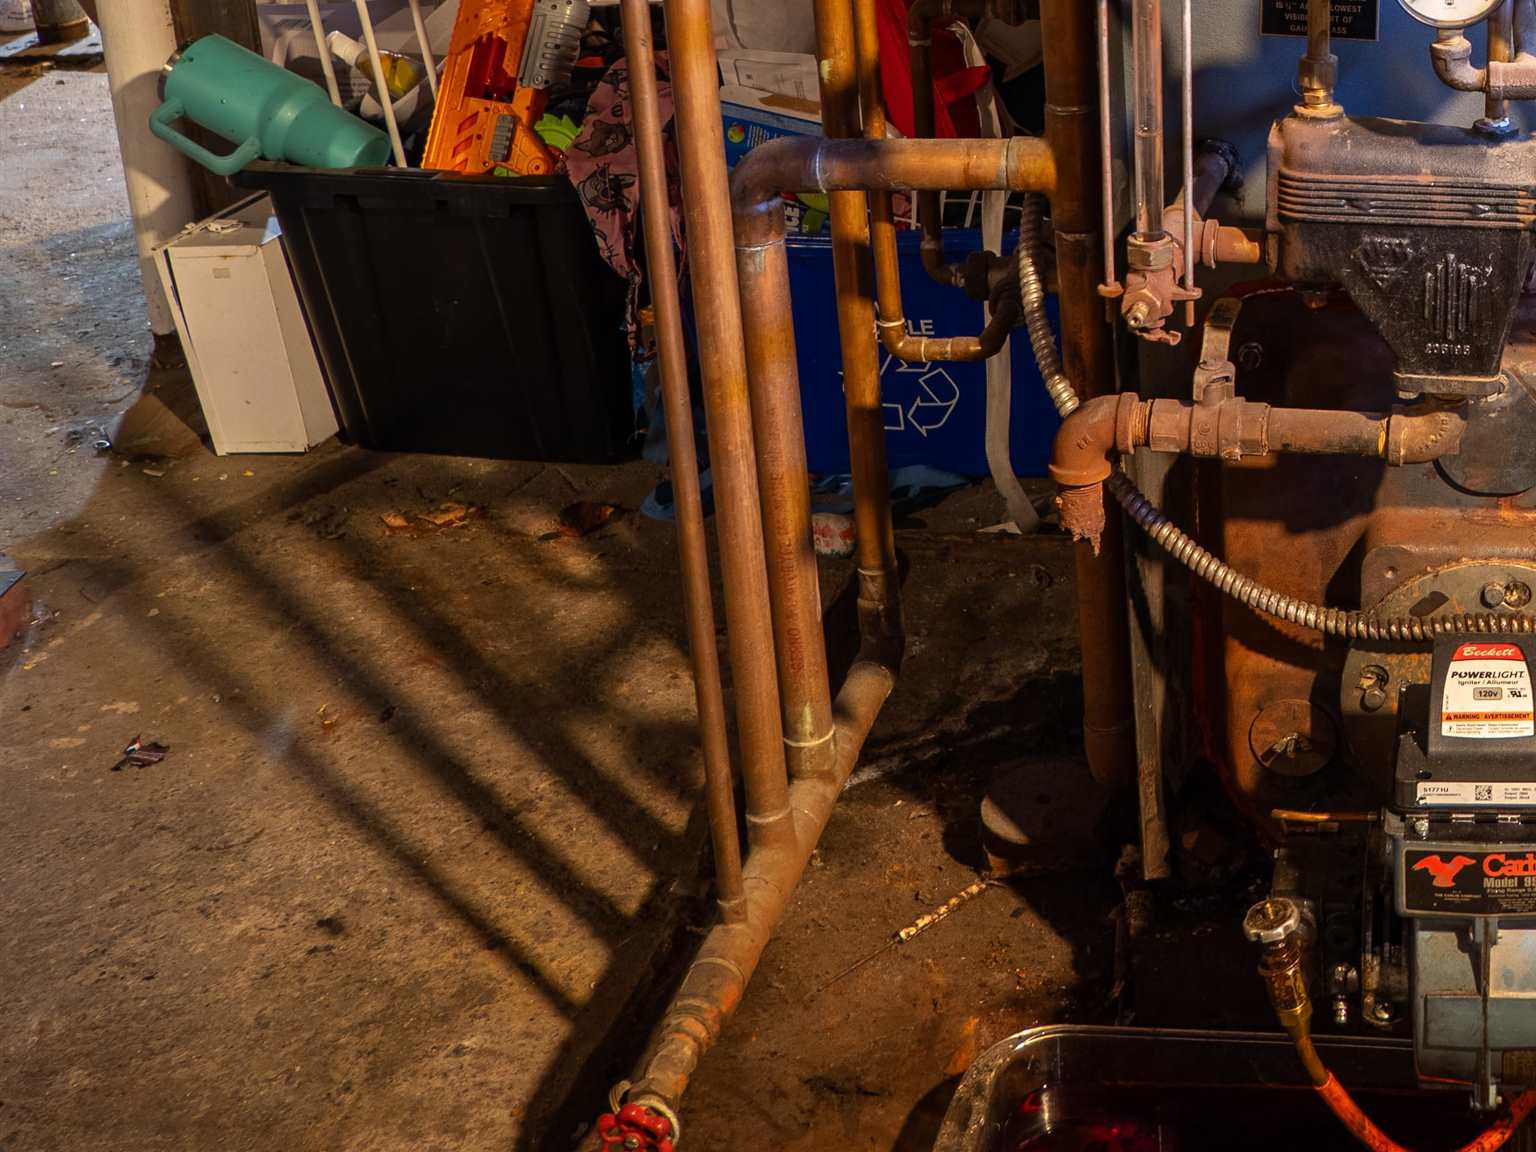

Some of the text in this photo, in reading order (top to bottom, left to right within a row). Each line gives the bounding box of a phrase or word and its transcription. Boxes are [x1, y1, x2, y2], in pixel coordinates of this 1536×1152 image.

[1462, 646, 1516, 657] Beckett
[1451, 671, 1524, 679] POWERLIGHT
[1478, 690, 1498, 698] 120v
[1483, 877, 1518, 888] Model
